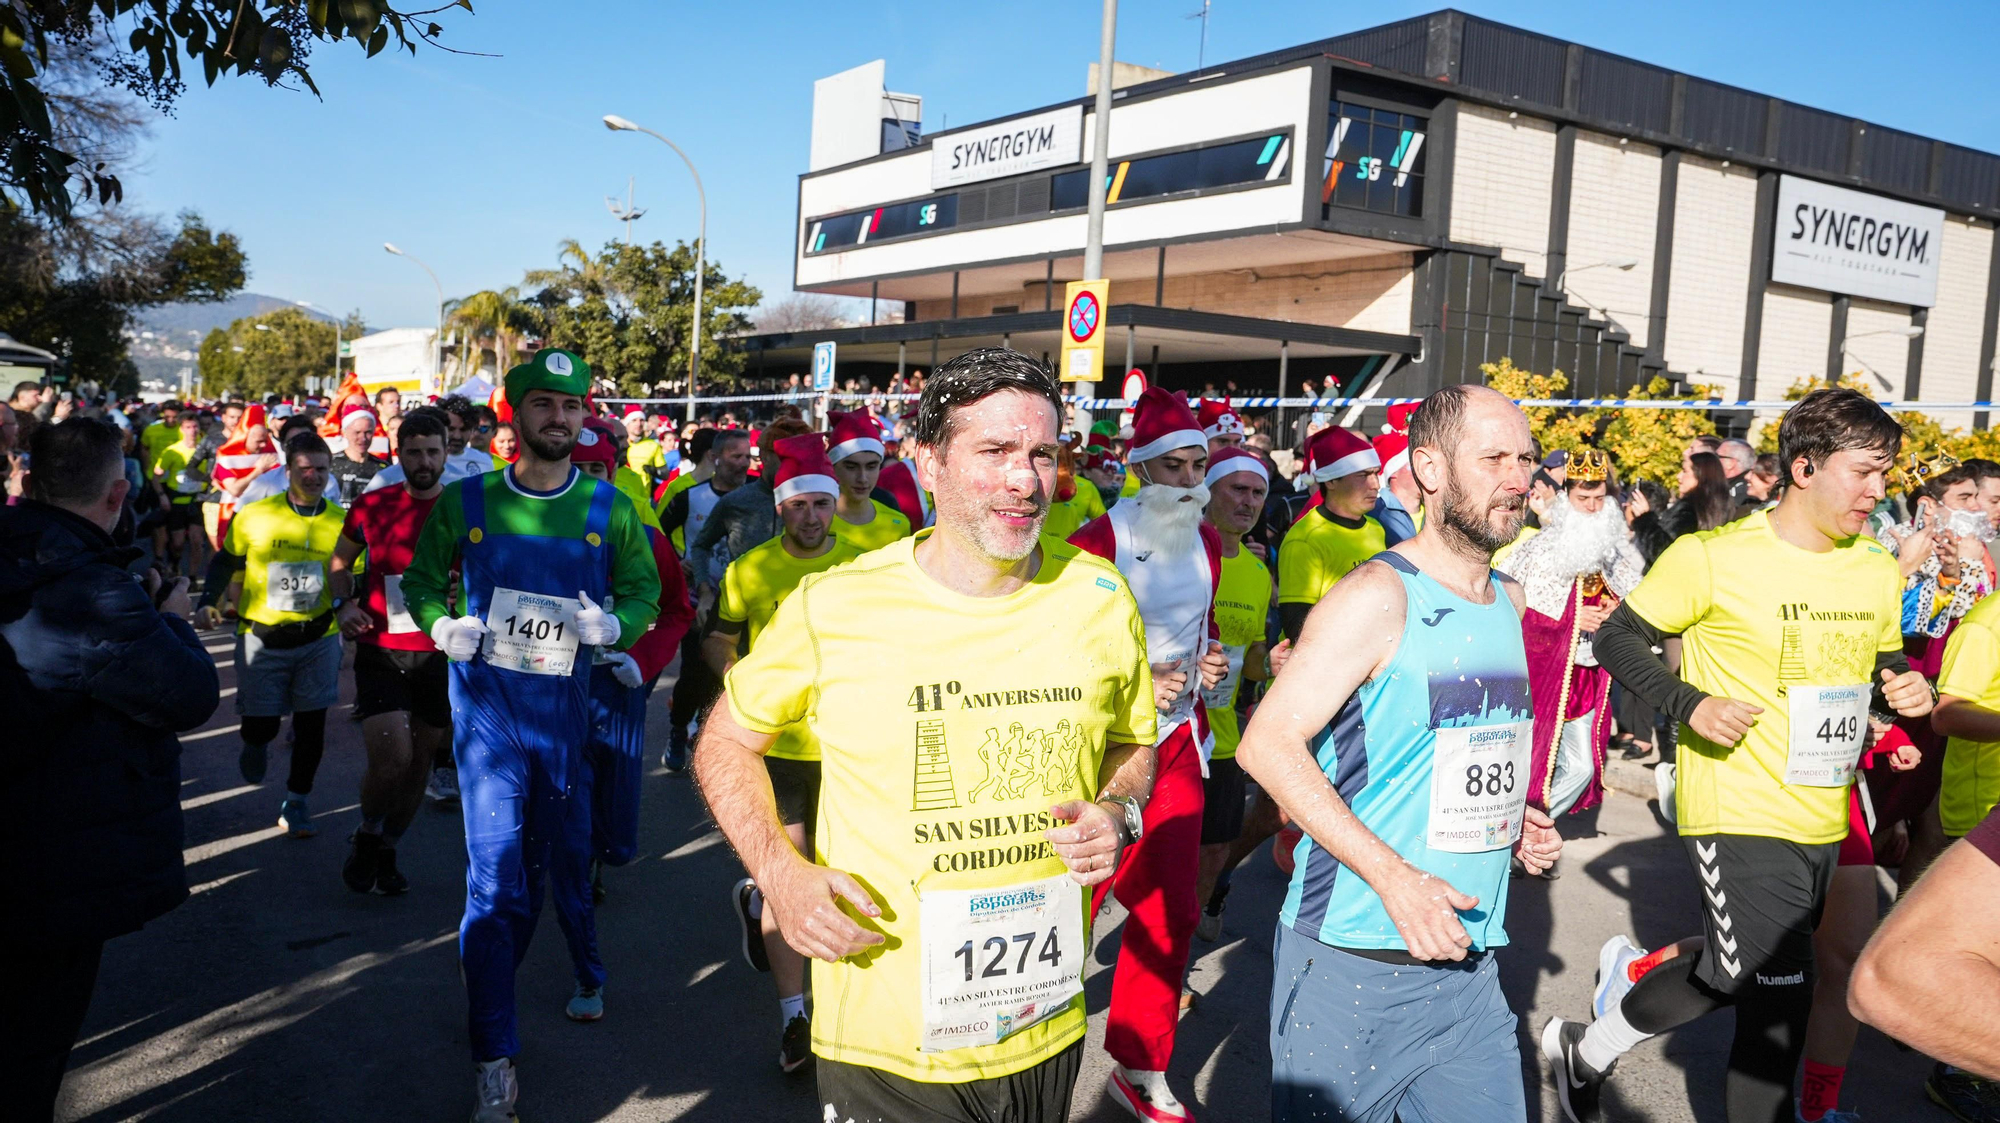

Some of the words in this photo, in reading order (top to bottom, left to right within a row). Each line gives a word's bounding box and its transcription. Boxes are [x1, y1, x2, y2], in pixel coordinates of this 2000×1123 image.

[951, 124, 1054, 170] SYNERGYM
[1356, 156, 1382, 181] SG
[919, 203, 937, 226] SG
[1791, 203, 1929, 264] SYNERGYM
[557, 355, 567, 371] L
[817, 348, 830, 385] P
[580, 428, 594, 442] M
[1809, 611, 1875, 621] ANIVERSARIO
[505, 615, 565, 642] 1401
[907, 680, 962, 713] 41º
[961, 686, 1083, 710] ANIVERSARIO
[1816, 715, 1857, 744] 449
[1465, 760, 1515, 797] 883
[1454, 806, 1469, 814] SAN
[1470, 803, 1504, 813] SILVESTRE
[914, 820, 964, 844] SAN
[1446, 830, 1481, 839] IMDECO
[970, 893, 1046, 912] populares
[954, 926, 1062, 982] 1274
[1756, 971, 1804, 986] hummel
[953, 992, 975, 1004] SAN
[975, 985, 1028, 1001] SILVESTRE
[979, 999, 1003, 1010] JAVIER
[1004, 995, 1025, 1006] RAMIS
[944, 1020, 989, 1035] IMDECO
